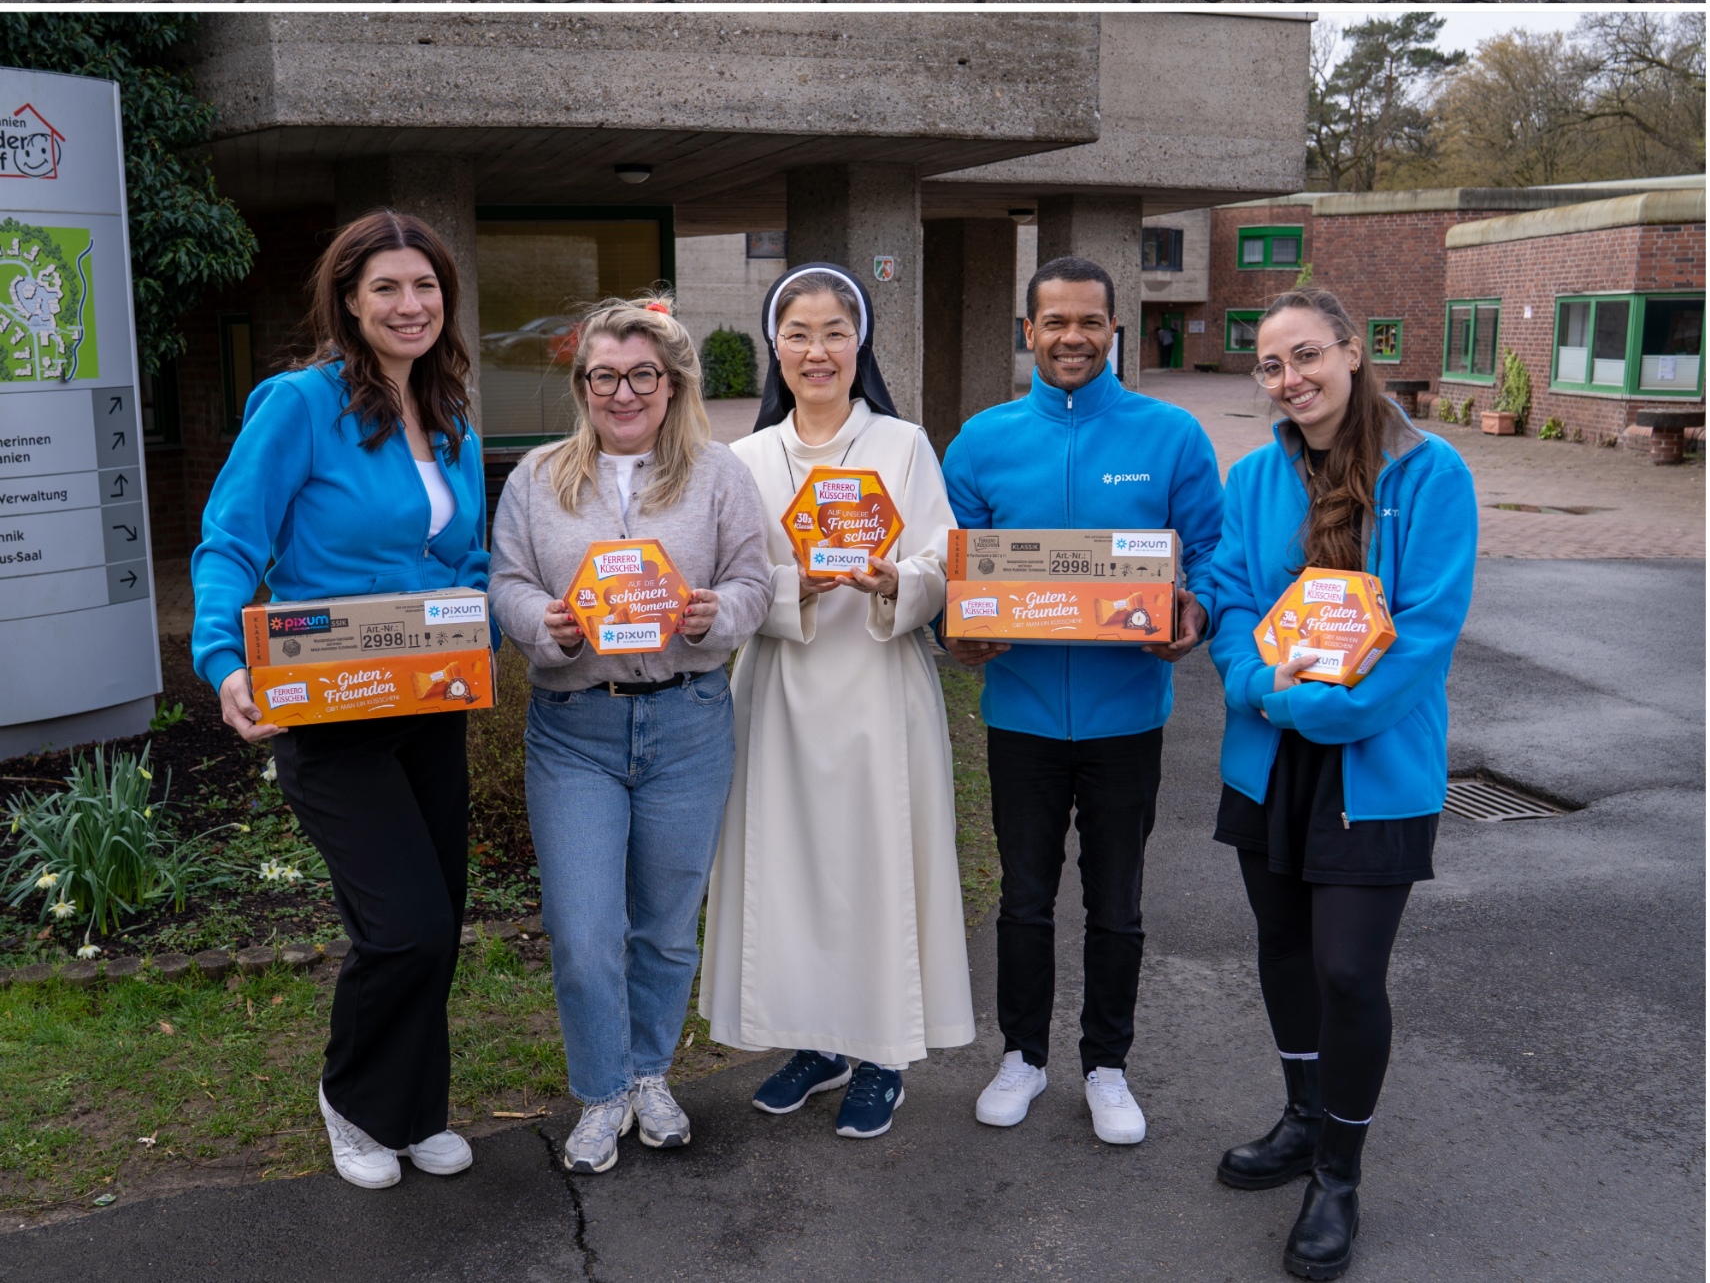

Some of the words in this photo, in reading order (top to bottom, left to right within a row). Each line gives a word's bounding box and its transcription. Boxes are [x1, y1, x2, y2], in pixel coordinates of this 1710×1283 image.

[1114, 473, 1150, 485] pixum
[823, 482, 855, 491] FERRERO
[820, 490, 857, 500] KÜSSCHEN
[828, 515, 883, 530] Freund-
[844, 528, 887, 543] schaft
[1128, 538, 1167, 551] pixum
[603, 555, 637, 563] FERRERO
[827, 555, 865, 566] pixum
[600, 564, 640, 573] KÜSSCHEN
[1051, 560, 1090, 573] 2998
[1312, 580, 1342, 592] FERRERO
[610, 587, 668, 604] schönen
[1026, 591, 1067, 604] Guten
[1307, 590, 1342, 602] KÜSSCHEN
[442, 604, 481, 618] pixum
[630, 600, 679, 614] Momente
[968, 601, 994, 609] FERRERO
[1012, 603, 1079, 620] Freunden
[1319, 605, 1357, 619] Guten
[285, 614, 329, 631] pixum
[1306, 618, 1368, 633] Freunden
[366, 625, 399, 634] Art.-Nr.:
[363, 633, 403, 648] 2998
[617, 630, 656, 643] pixum
[338, 669, 382, 686] Guten
[274, 687, 303, 696] FERRERO
[324, 681, 396, 703] Freunden
[272, 694, 306, 704] KÜSSCHEN
[340, 702, 354, 710] MAN
